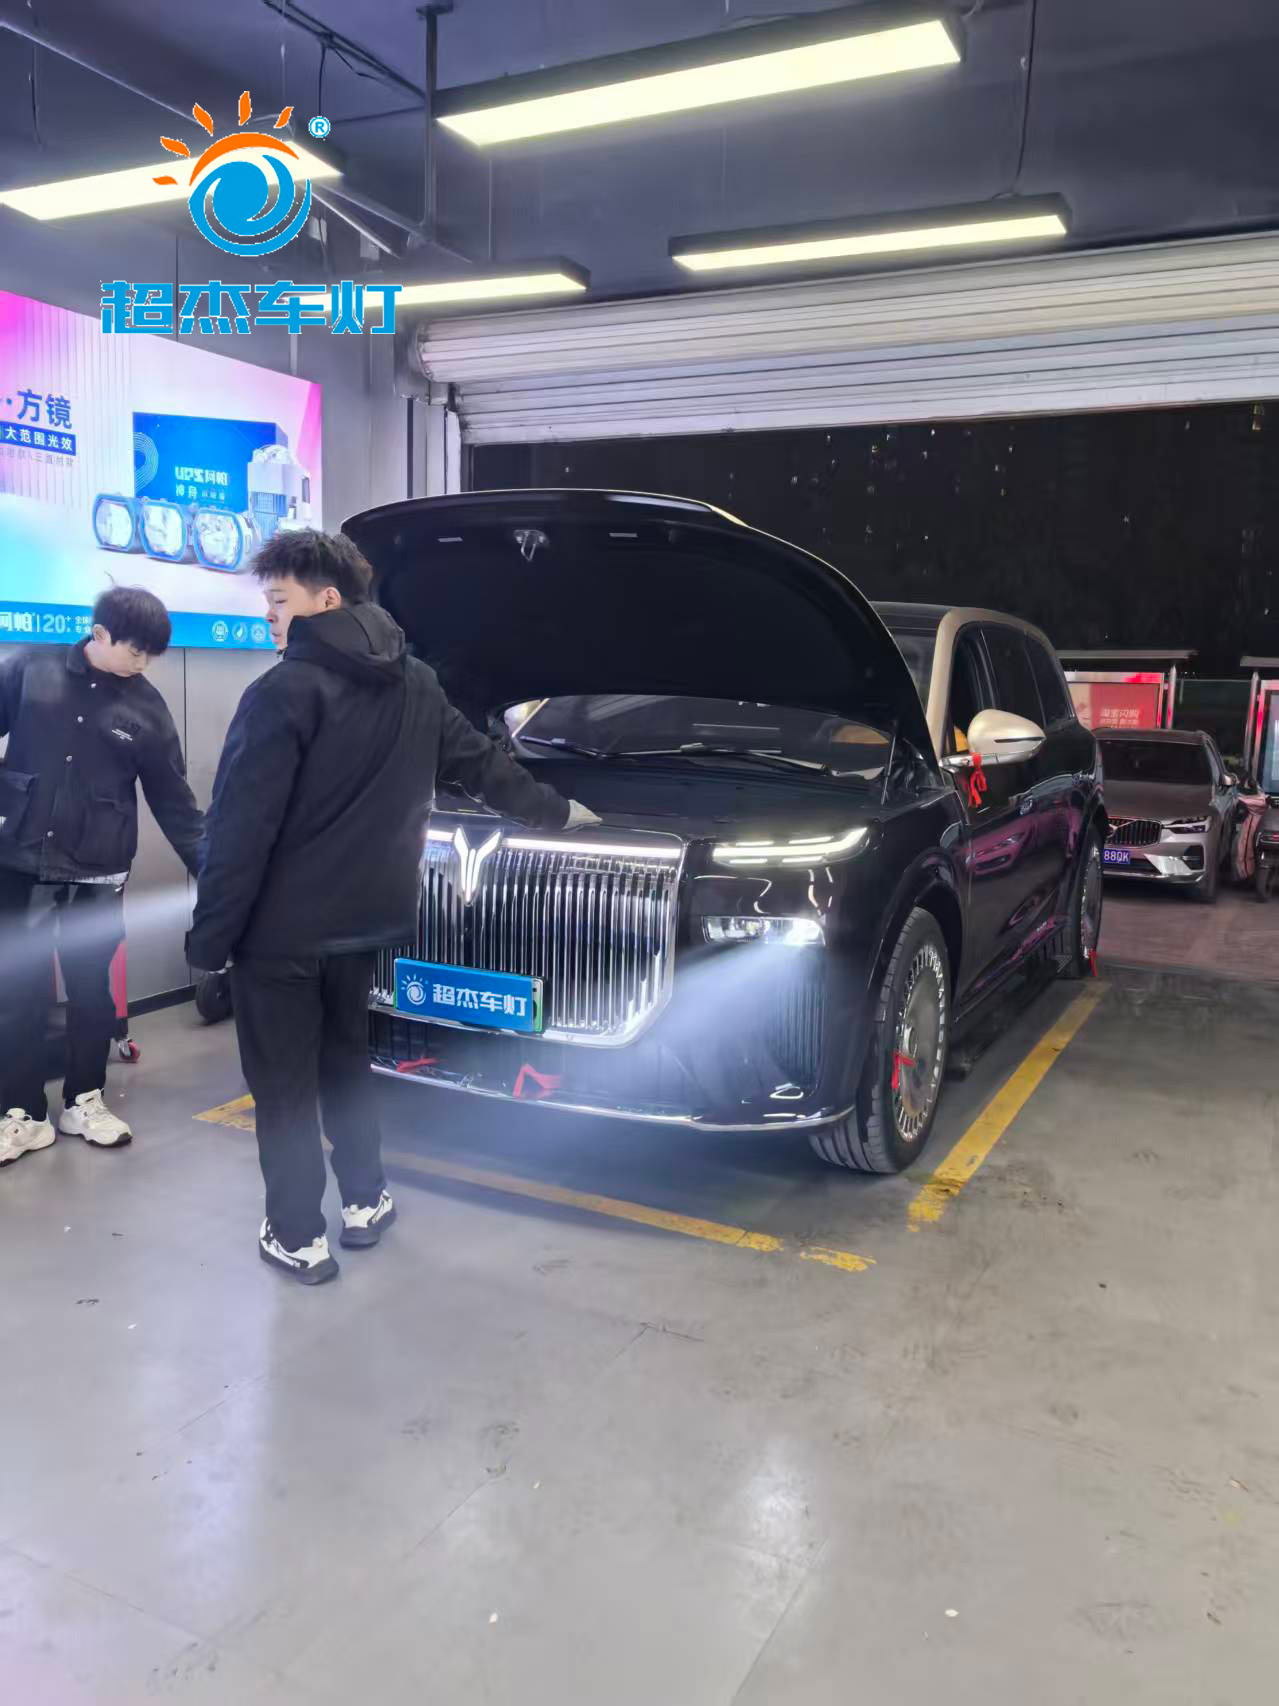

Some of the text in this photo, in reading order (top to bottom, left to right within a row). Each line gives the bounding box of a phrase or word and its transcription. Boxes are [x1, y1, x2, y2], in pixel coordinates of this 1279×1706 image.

[5, 426, 73, 451] 大范围光效
[432, 983, 528, 1017] 超杰车灯
